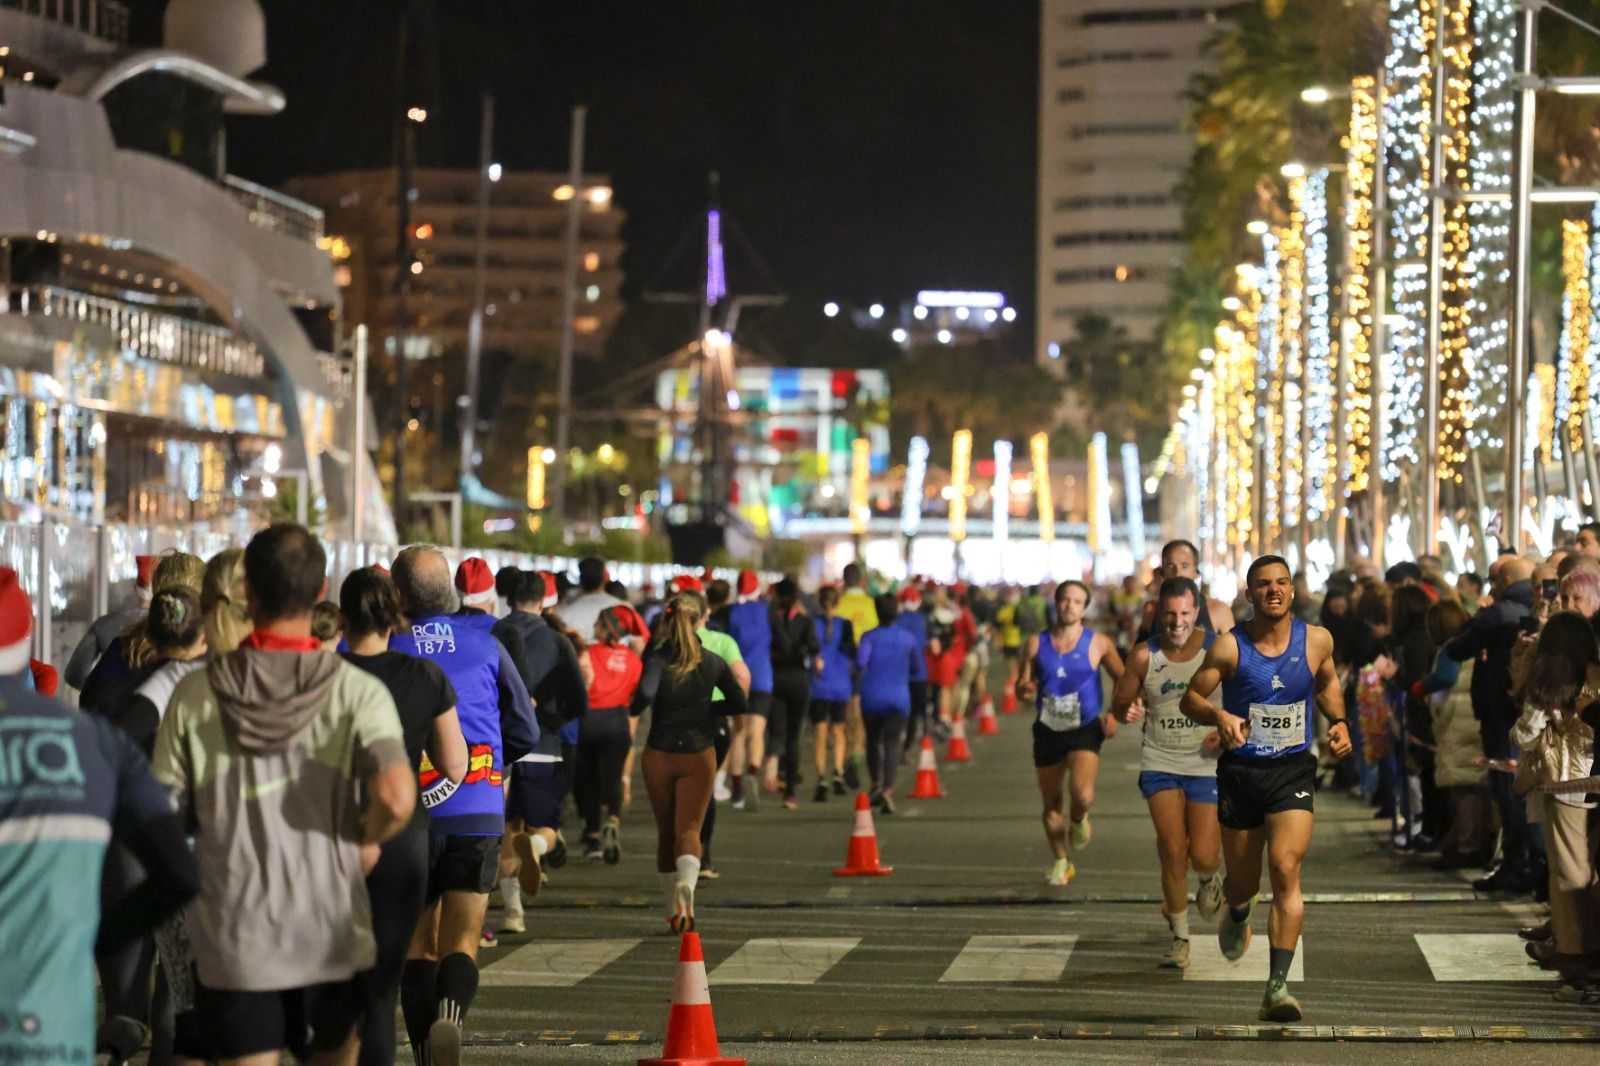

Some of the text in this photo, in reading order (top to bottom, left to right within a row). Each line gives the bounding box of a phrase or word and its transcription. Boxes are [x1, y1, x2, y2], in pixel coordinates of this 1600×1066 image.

[412, 622, 453, 638] RCM
[415, 639, 456, 655] 1873
[1159, 717, 1194, 729] 1250
[1261, 717, 1291, 729] 528
